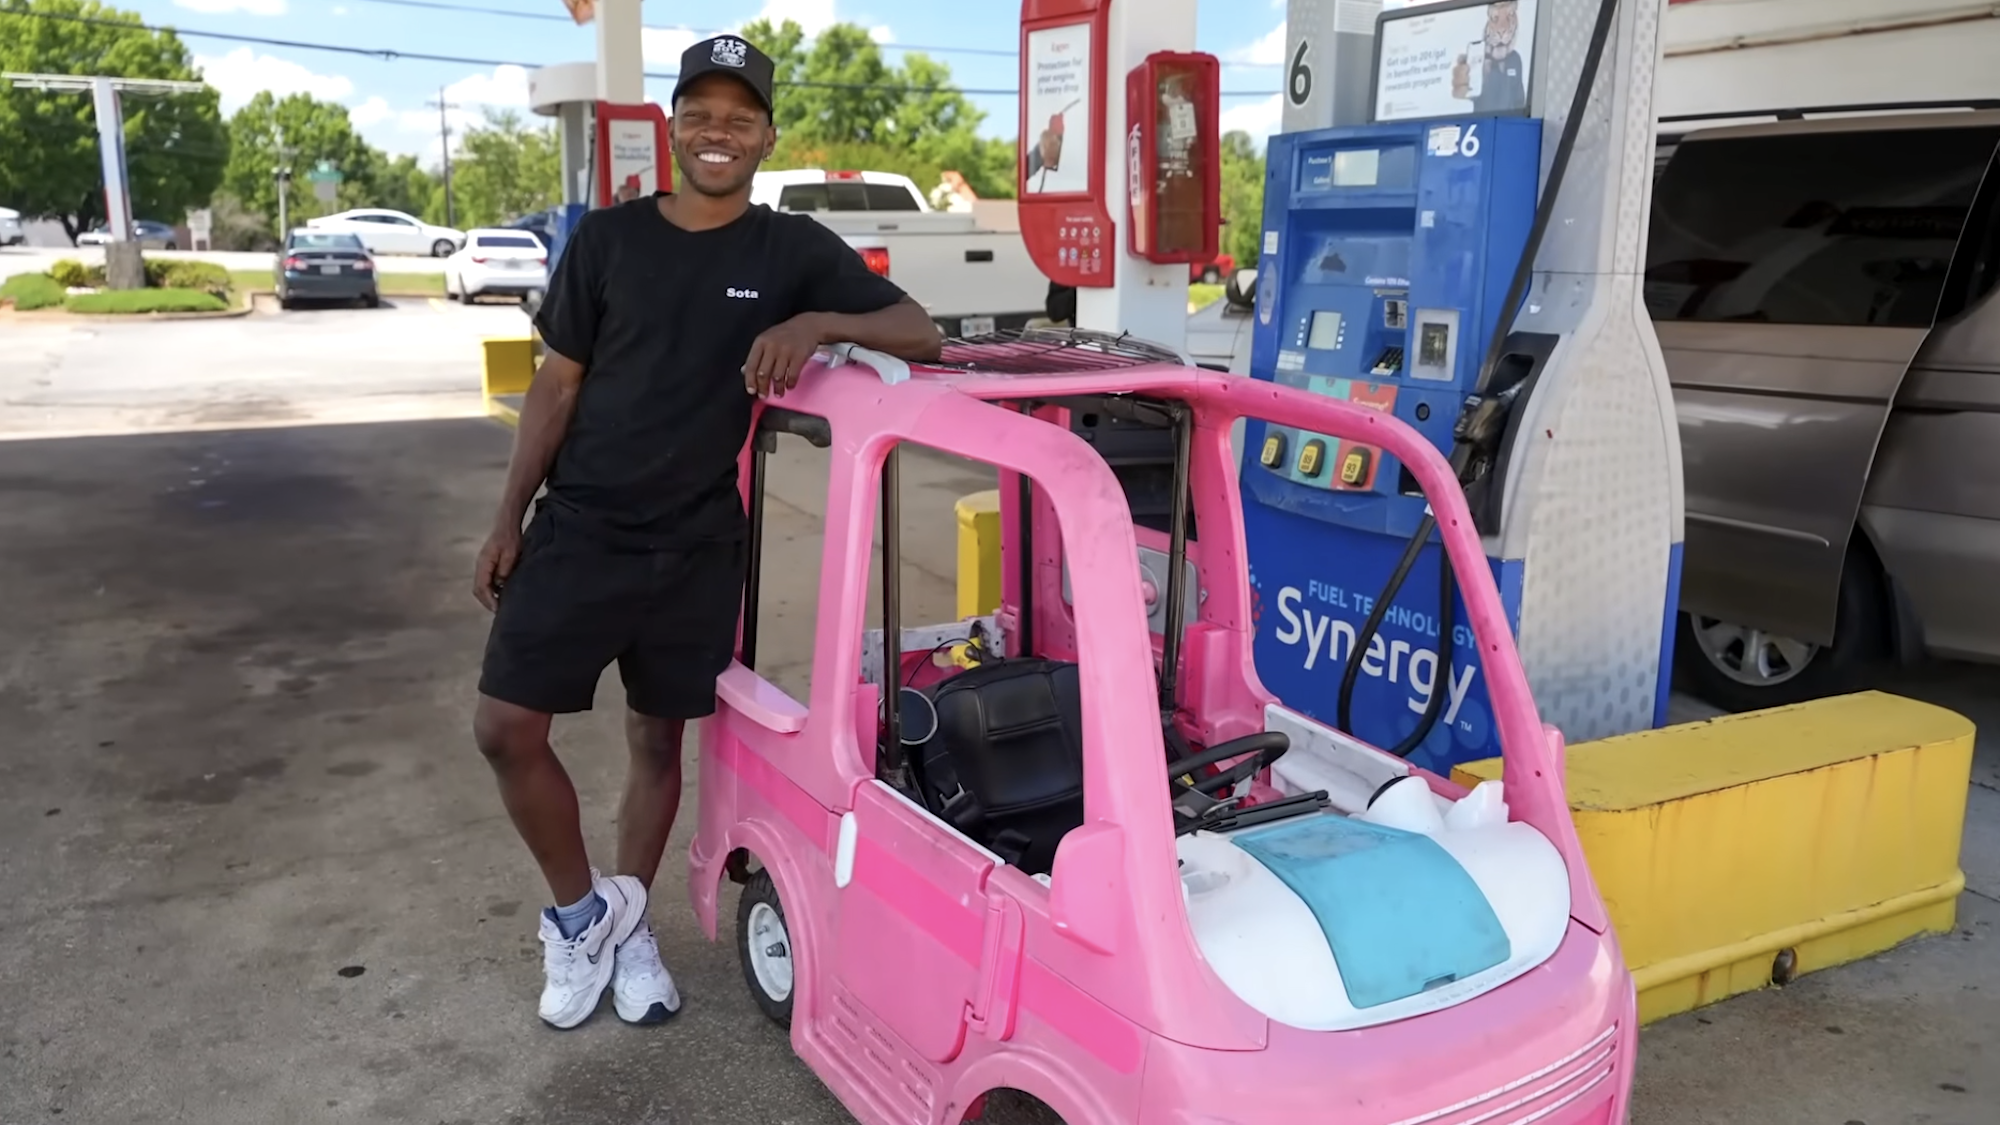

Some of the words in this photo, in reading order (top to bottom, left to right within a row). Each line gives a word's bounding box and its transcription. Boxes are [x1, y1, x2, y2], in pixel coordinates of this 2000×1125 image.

[1290, 40, 1311, 105] 6
[1461, 124, 1479, 157] 6
[726, 287, 759, 299] Sota
[1346, 463, 1356, 474] 93
[1309, 580, 1348, 608] FUEL
[1353, 593, 1475, 649] TEHNOLGY
[1276, 586, 1476, 725] Synergy
